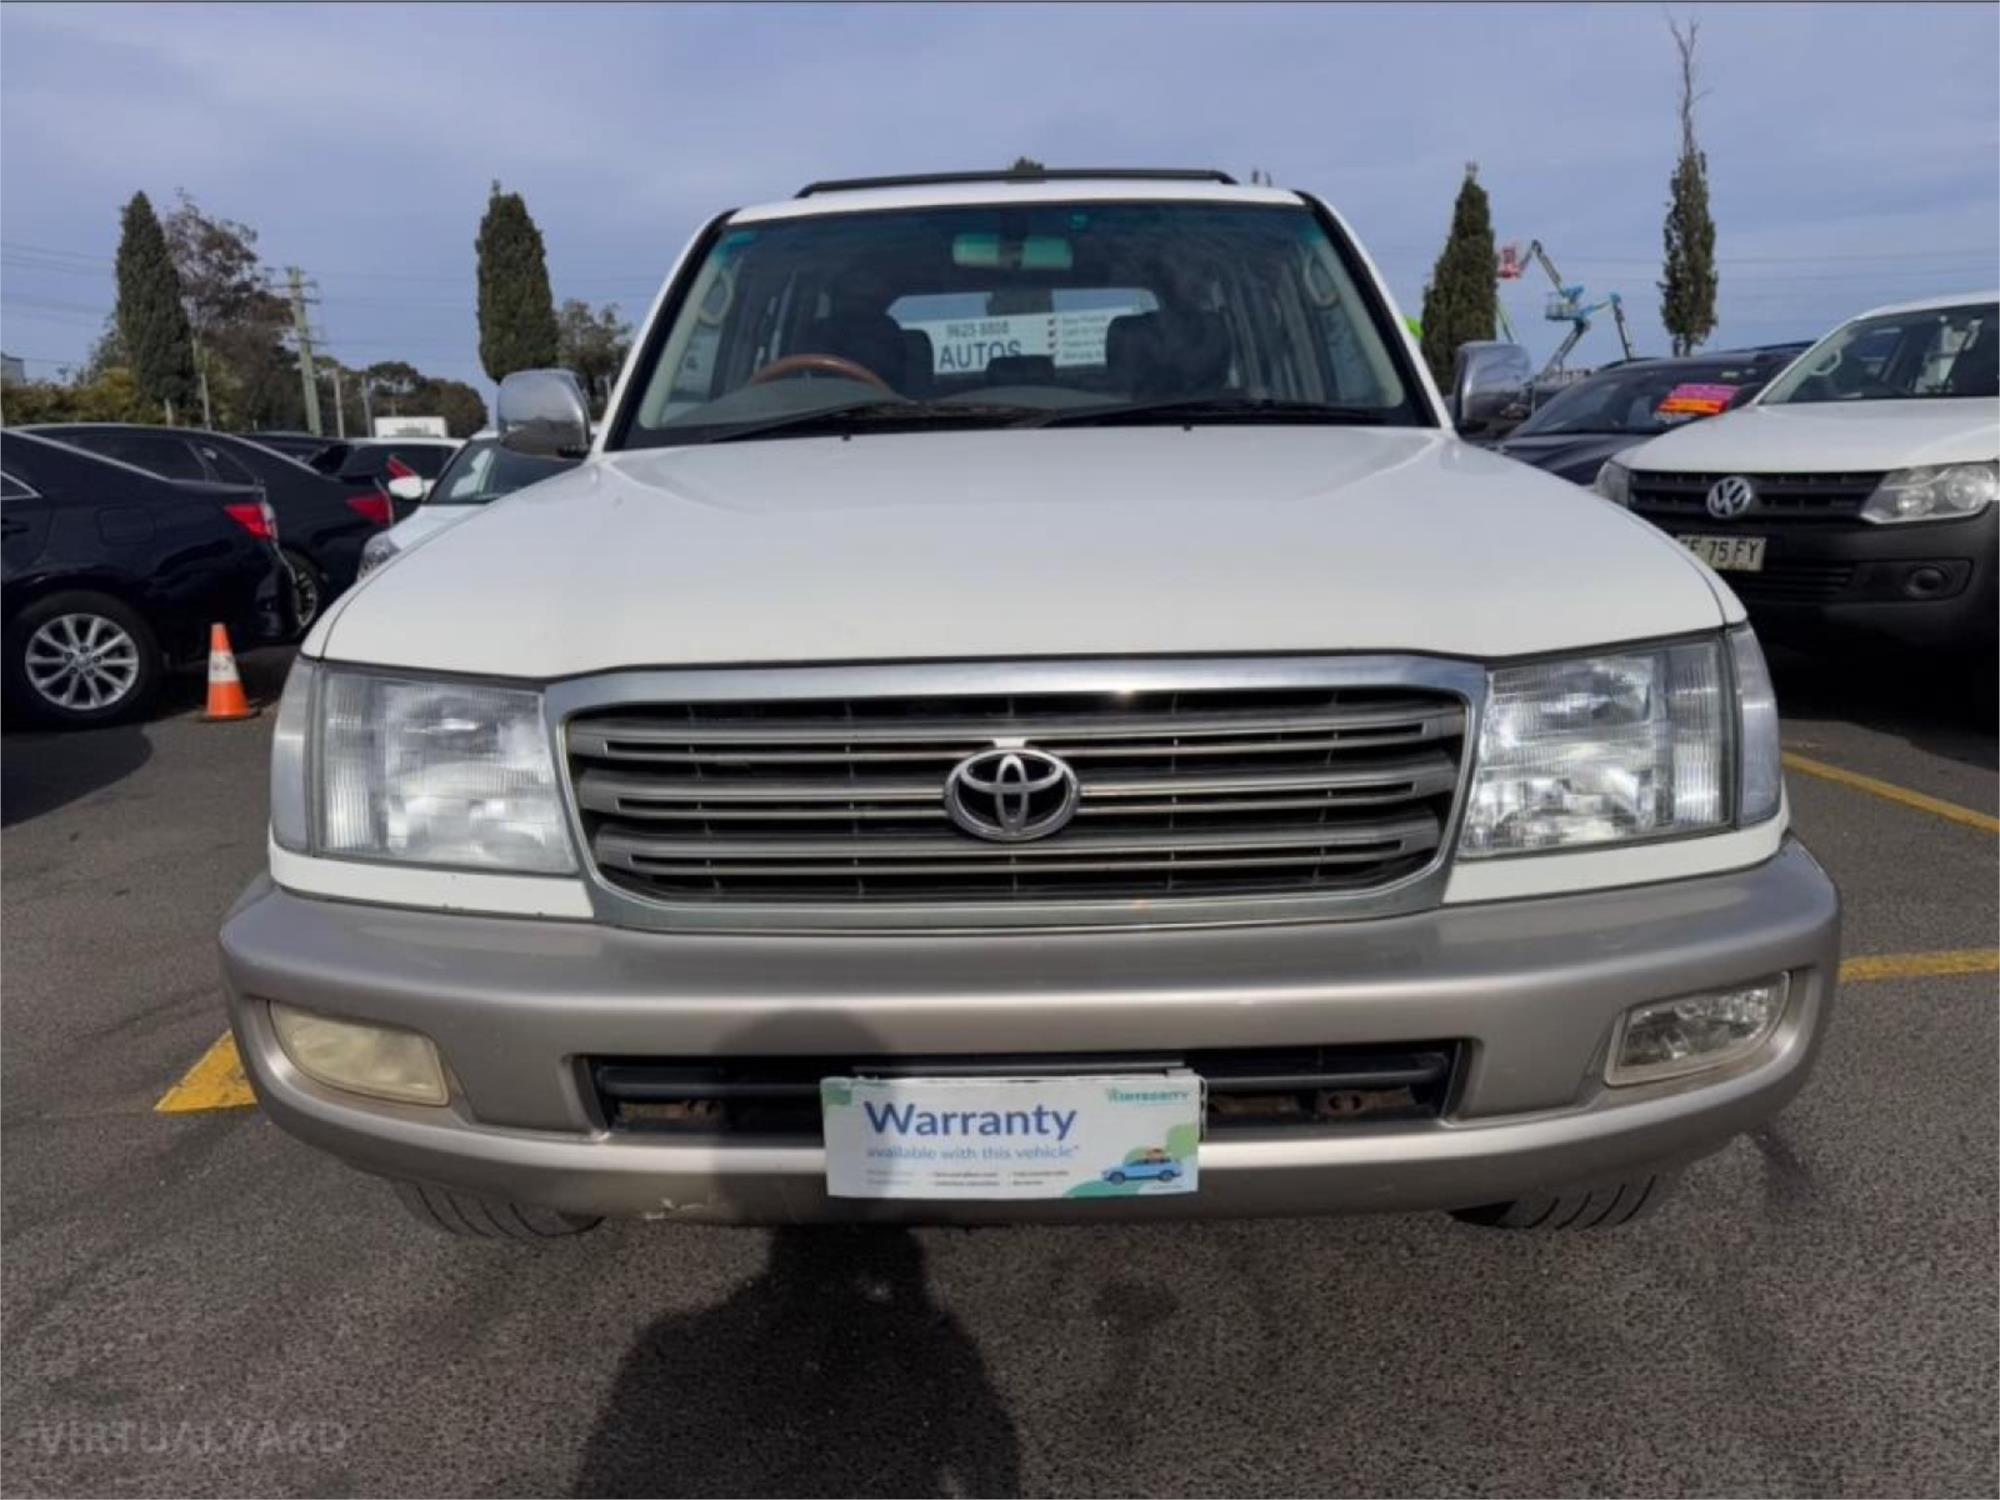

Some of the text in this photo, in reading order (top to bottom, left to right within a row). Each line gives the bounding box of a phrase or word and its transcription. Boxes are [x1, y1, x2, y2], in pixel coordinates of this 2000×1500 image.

[939, 340, 1021, 370] AUTOS
[1707, 540, 1730, 563] 75
[1735, 540, 1759, 563] FY
[863, 1100, 1078, 1141] Warranty
[865, 1143, 935, 1160] available
[940, 1143, 977, 1160] with
[982, 1143, 1011, 1160] this
